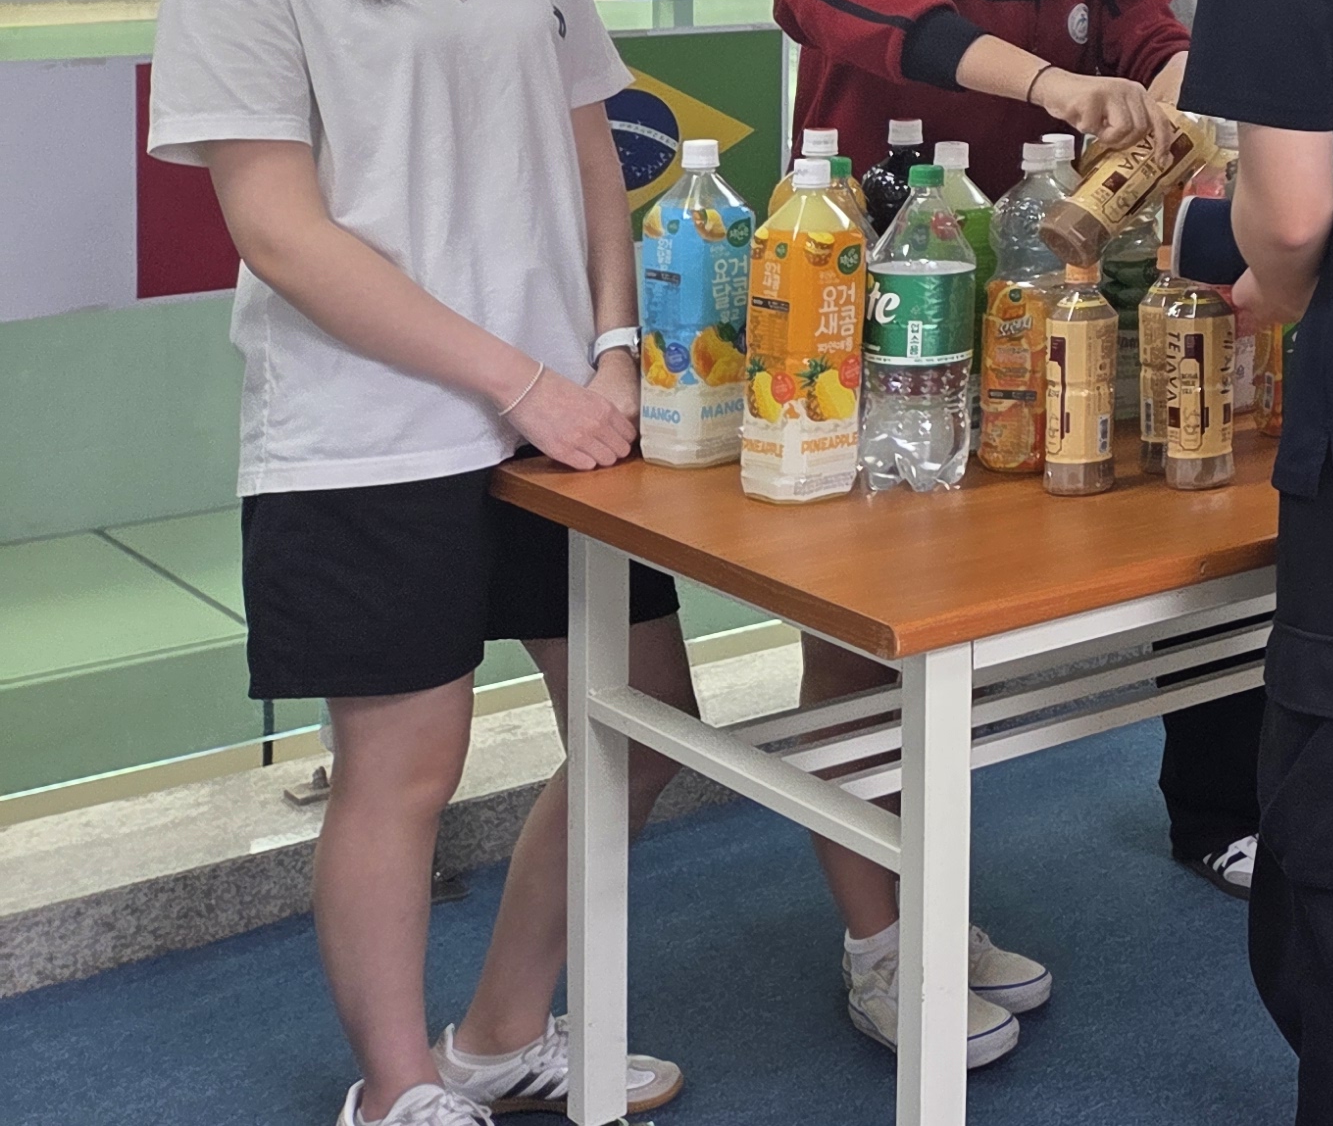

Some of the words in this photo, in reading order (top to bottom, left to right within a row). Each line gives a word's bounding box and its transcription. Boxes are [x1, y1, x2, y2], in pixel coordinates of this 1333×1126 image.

[710, 255, 748, 285] 요거
[711, 276, 749, 311] 달콤
[818, 281, 857, 314] 요거
[814, 304, 858, 337] 새콤
[909, 323, 921, 356] 업소용
[642, 405, 681, 425] MANGO
[700, 397, 745, 421] MANG
[800, 430, 858, 455] PINEAPPLE
